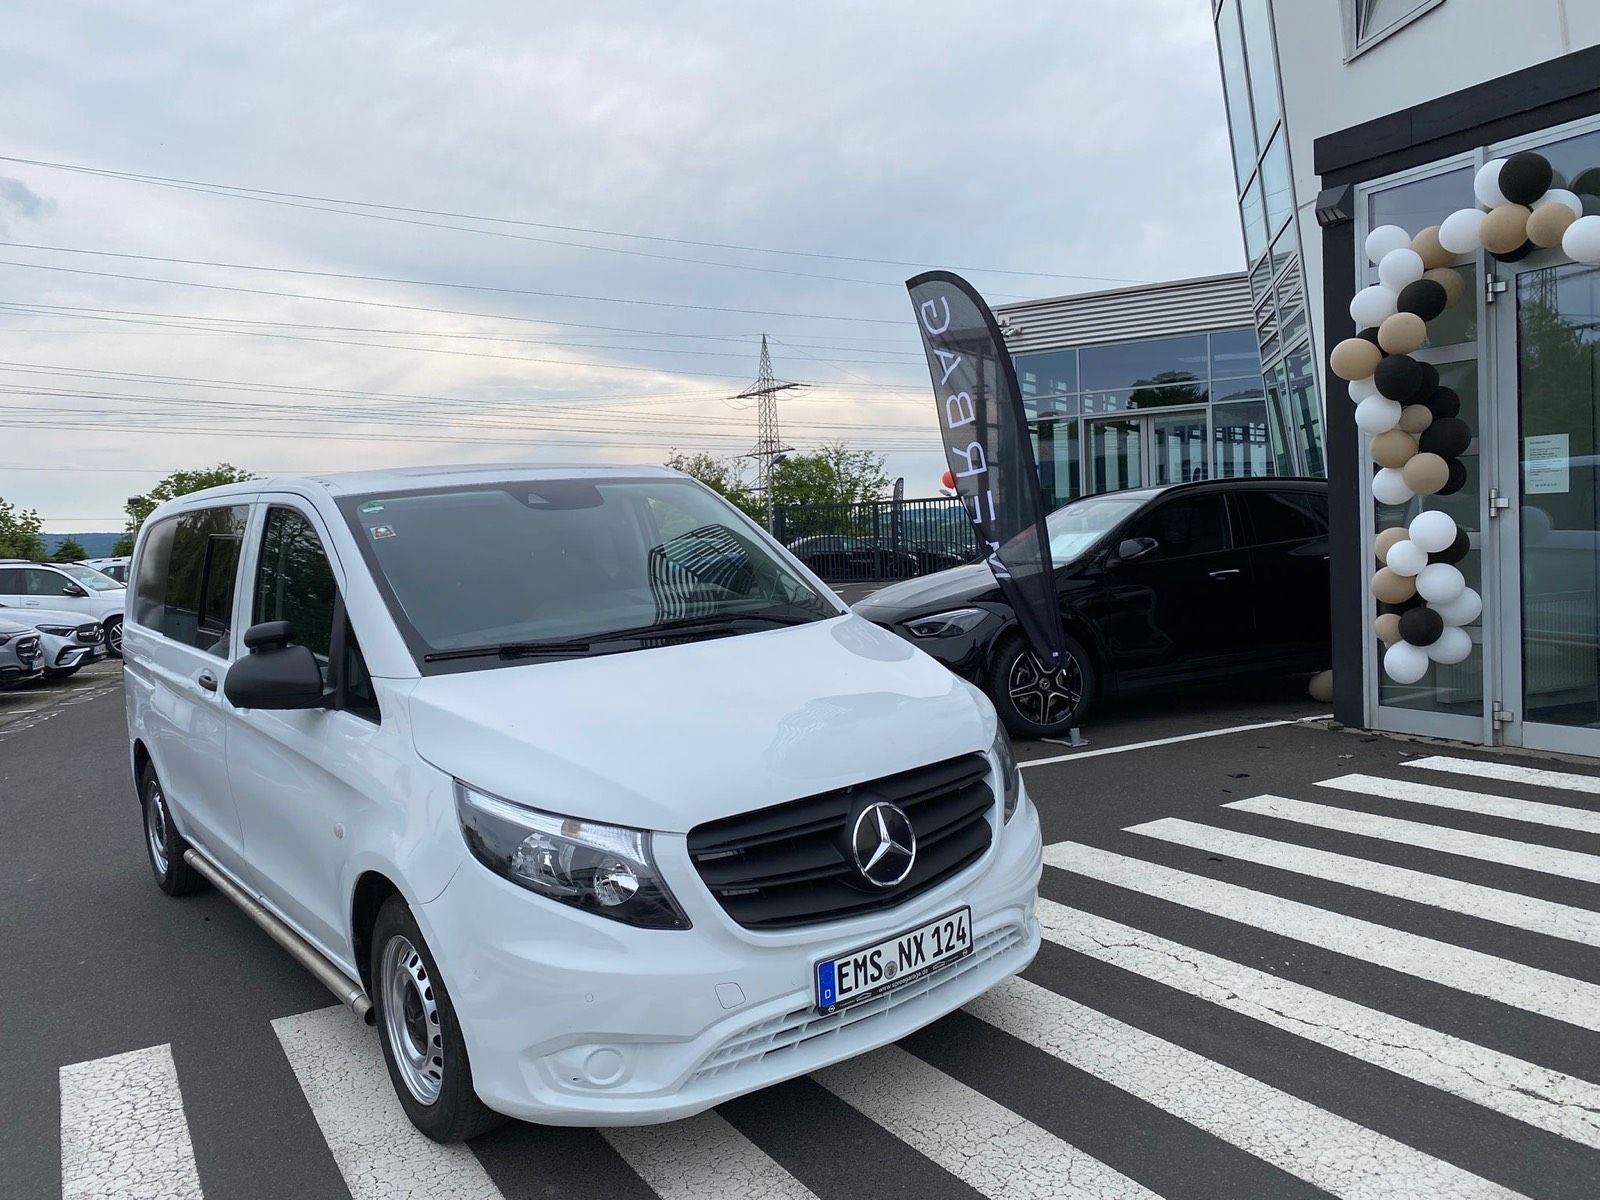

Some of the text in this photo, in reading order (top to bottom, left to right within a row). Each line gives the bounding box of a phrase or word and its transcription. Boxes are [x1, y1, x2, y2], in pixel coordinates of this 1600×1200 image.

[837, 916, 967, 995] EMS NX 124
[824, 989, 832, 999] D
